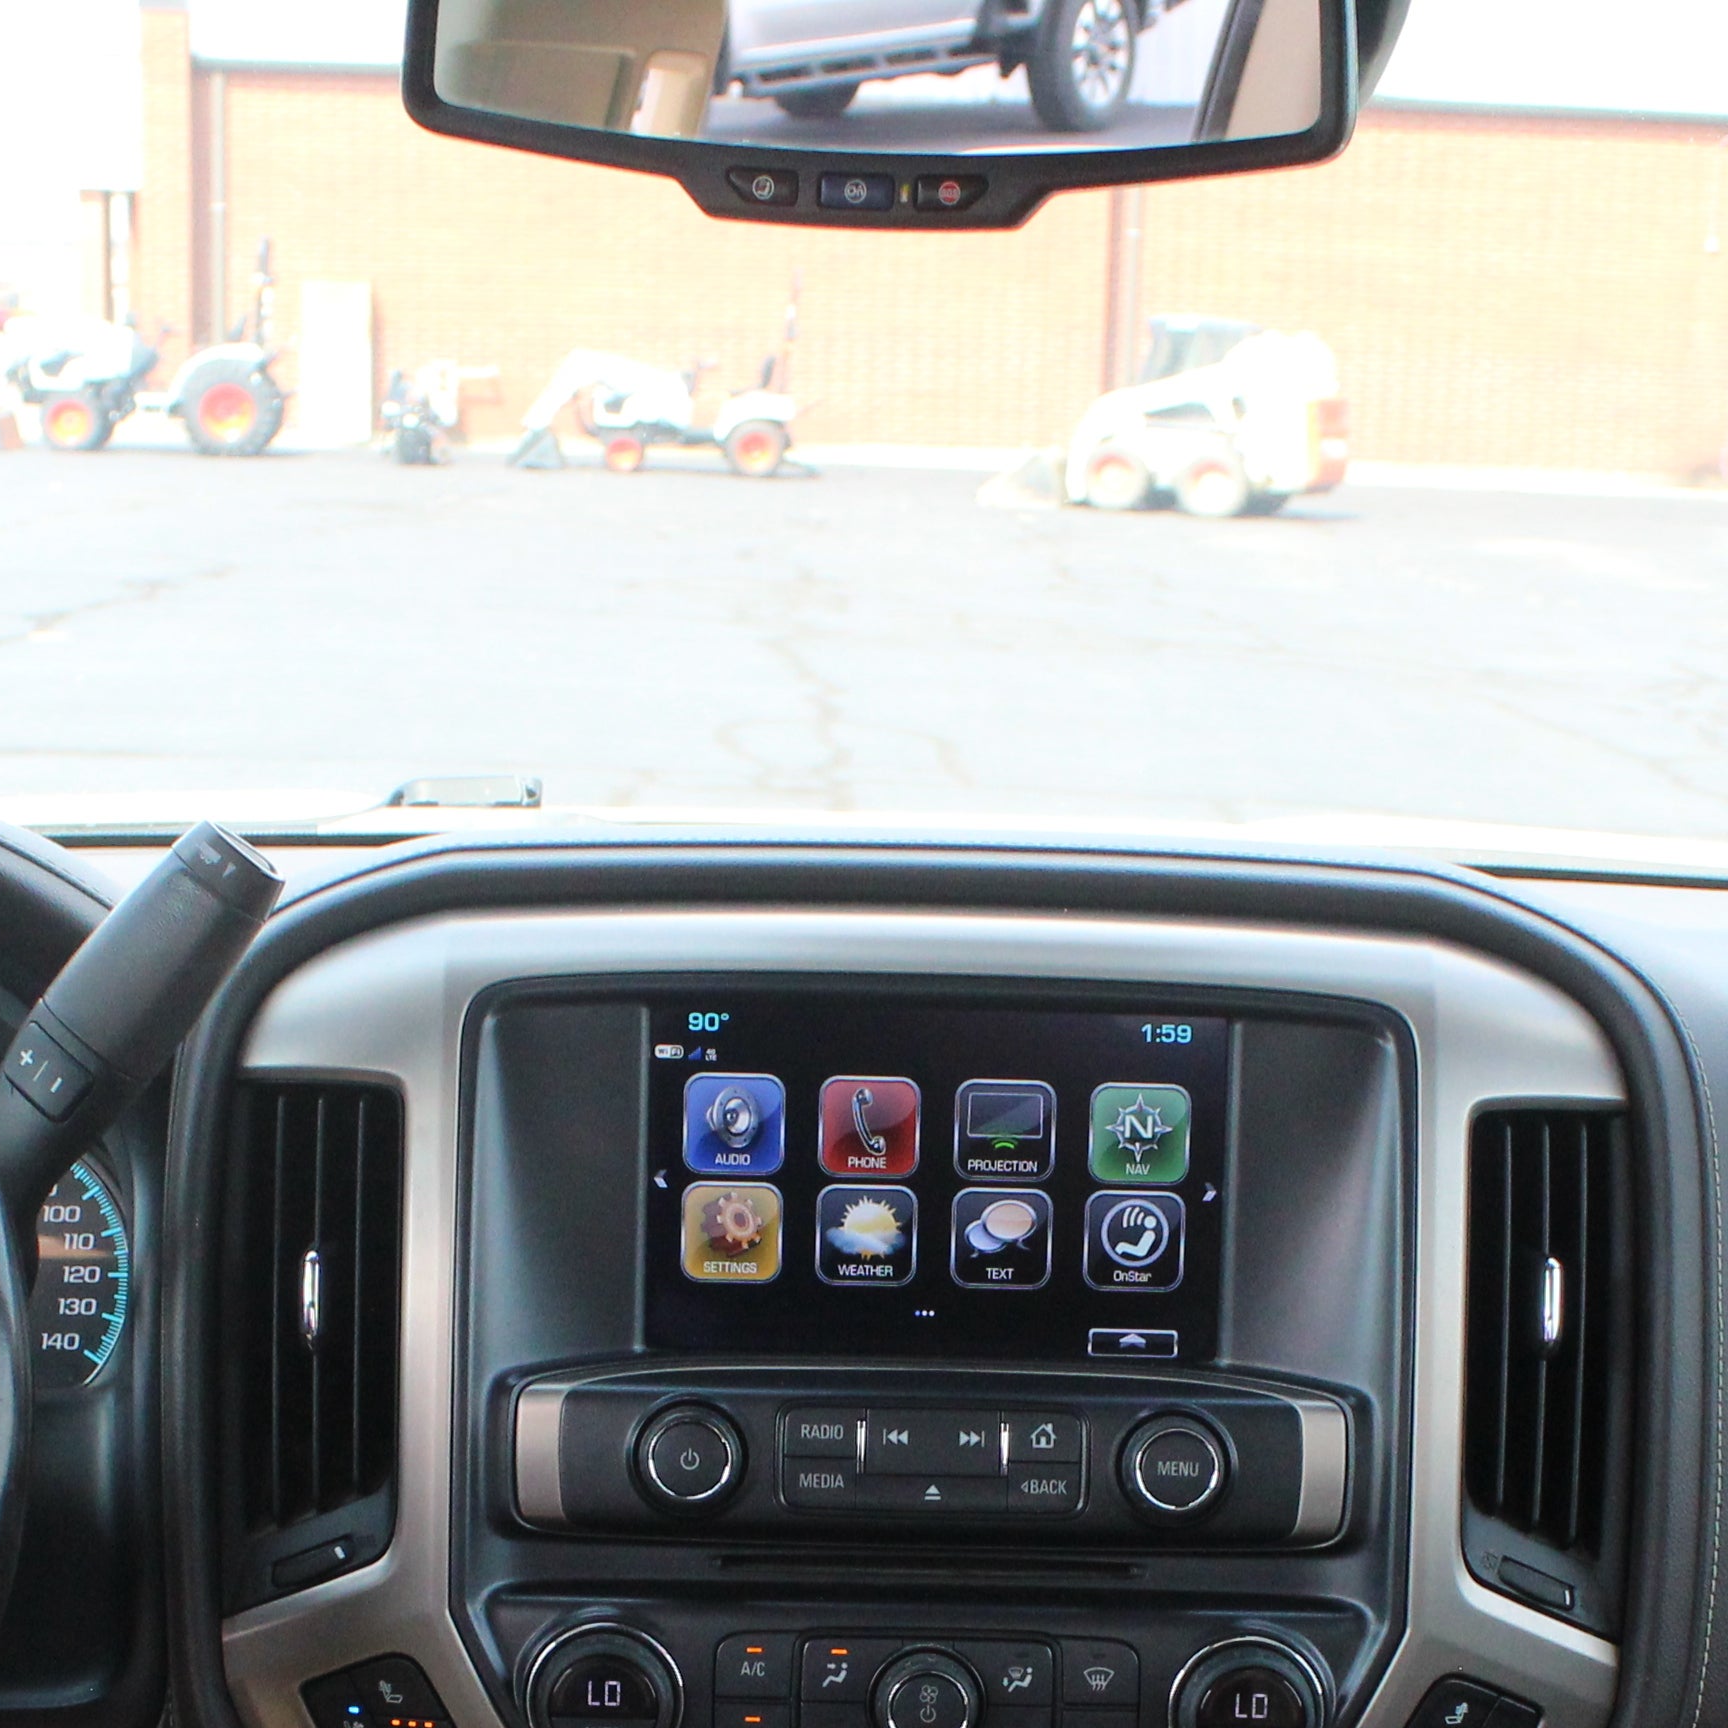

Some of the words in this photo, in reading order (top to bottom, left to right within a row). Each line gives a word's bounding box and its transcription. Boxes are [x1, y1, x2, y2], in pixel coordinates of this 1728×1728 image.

[1141, 1024, 1192, 1043] 1:59
[715, 1153, 751, 1167] AUDIO
[847, 1156, 887, 1169] PHONE
[967, 1159, 1038, 1173] PROJECTION
[1125, 1163, 1150, 1176] NAV
[42, 1204, 81, 1224] 100
[64, 1232, 94, 1250] 110
[63, 1265, 101, 1284] 120
[703, 1261, 758, 1275] SETTINGS
[838, 1264, 894, 1278] WEATHER
[986, 1268, 1014, 1280] TEXT
[1113, 1270, 1152, 1282] OnStar
[57, 1298, 97, 1316] 130
[41, 1332, 80, 1351] 140
[800, 1424, 844, 1441] RADIO
[1157, 1460, 1200, 1478] MENU
[799, 1472, 845, 1490] MEDIA
[1030, 1479, 1068, 1496] BACK
[740, 1661, 766, 1677] A/C
